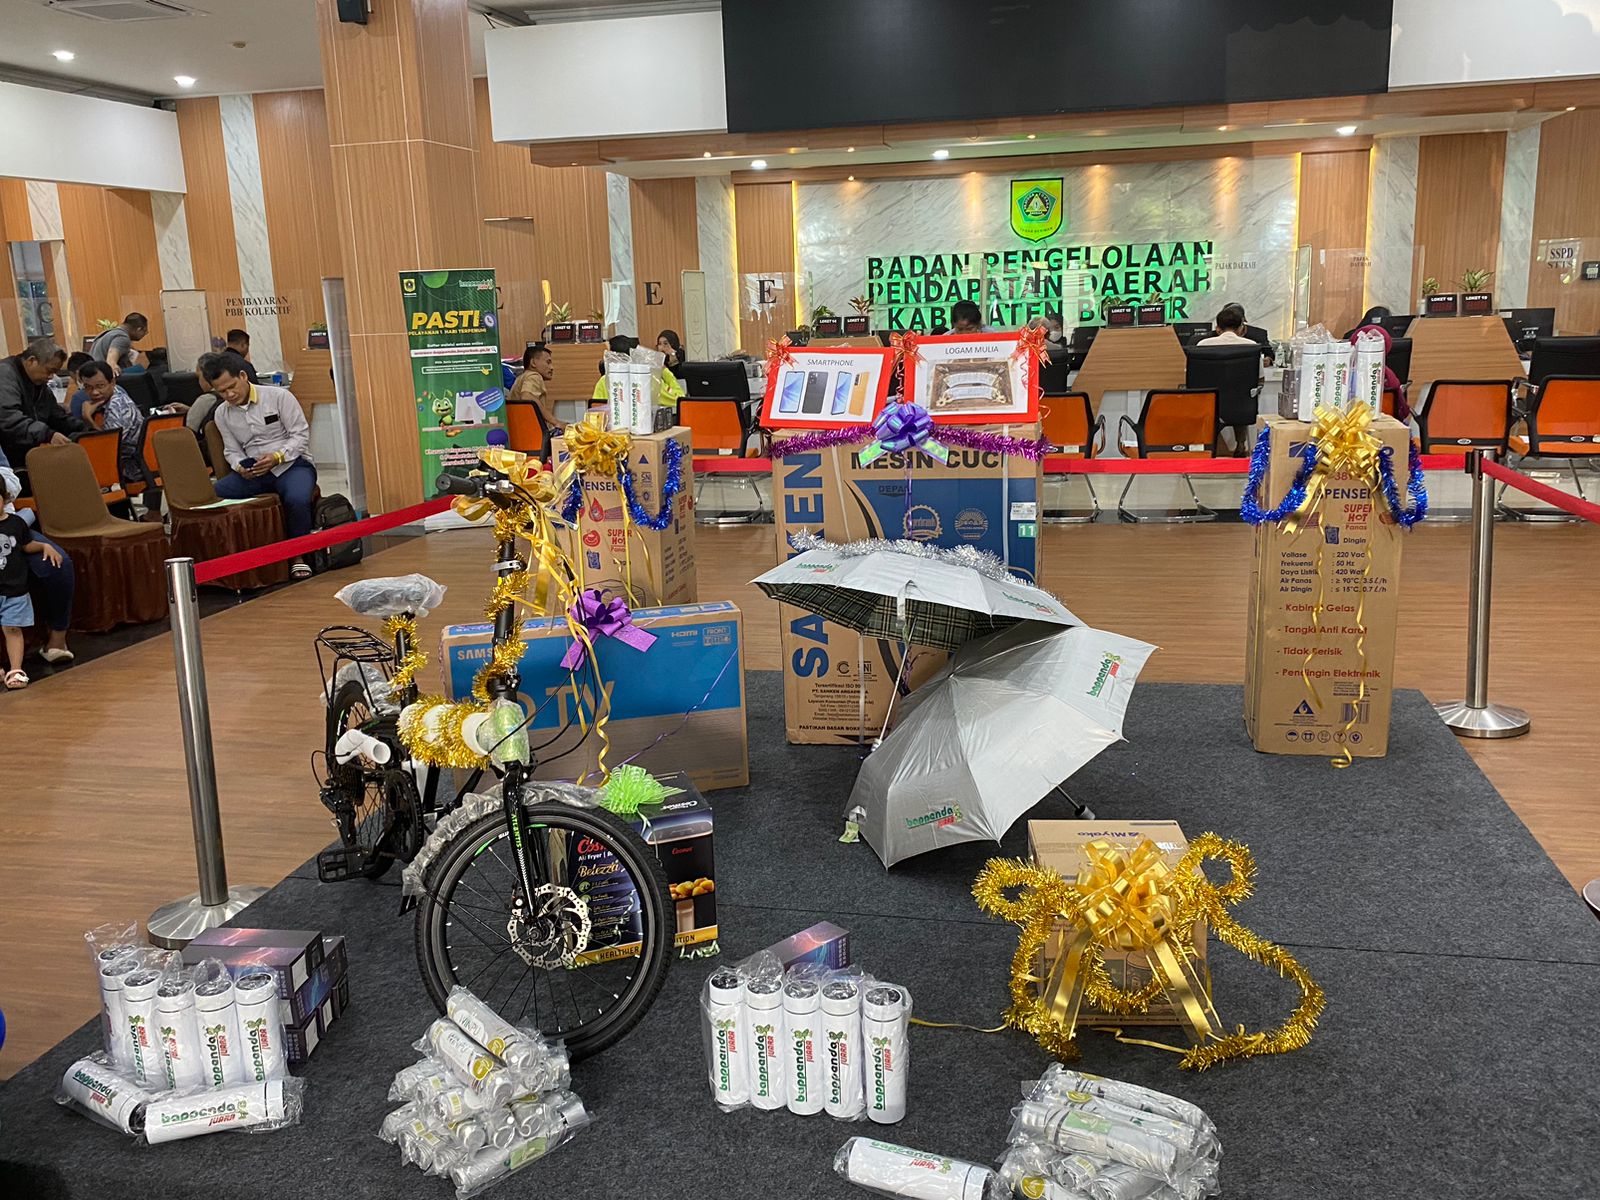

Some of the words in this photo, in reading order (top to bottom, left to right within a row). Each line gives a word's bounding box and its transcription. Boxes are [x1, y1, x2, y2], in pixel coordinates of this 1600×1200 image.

[1550, 247, 1574, 259] SSPD
[868, 254, 970, 280] BADAN
[984, 241, 1213, 274] PENGELOLAAN
[644, 281, 664, 305] E
[757, 279, 777, 304] E
[868, 276, 1063, 305] PENDAPATAN
[1079, 269, 1212, 298] DAERAH
[226, 296, 288, 306] PEMBAYARAN
[225, 308, 243, 317] PBB
[244, 306, 290, 316] KOLEKTIF
[888, 302, 1063, 331] KABATEN
[412, 310, 480, 330] PASTI
[945, 347, 971, 355] LOGAM
[974, 345, 999, 353] MULIA
[851, 450, 934, 469] MESIN
[585, 481, 618, 491] ENSER
[1348, 513, 1368, 521] HOT
[1019, 524, 1035, 536] 11
[1326, 604, 1355, 612] Gelas
[1284, 626, 1316, 635] Tangki
[1320, 626, 1339, 634] Anti
[1341, 627, 1368, 635] Karat
[457, 649, 492, 660] SAMS
[1283, 648, 1309, 656] Tidak
[1282, 669, 1331, 678] Pendingin
[1333, 669, 1381, 678] Elektronik
[546, 681, 615, 729] TV
[676, 935, 695, 944] ITION
[600, 945, 640, 960] HEALTHIER
[248, 1029, 265, 1082] appenda
[755, 1036, 767, 1097] bappenda
